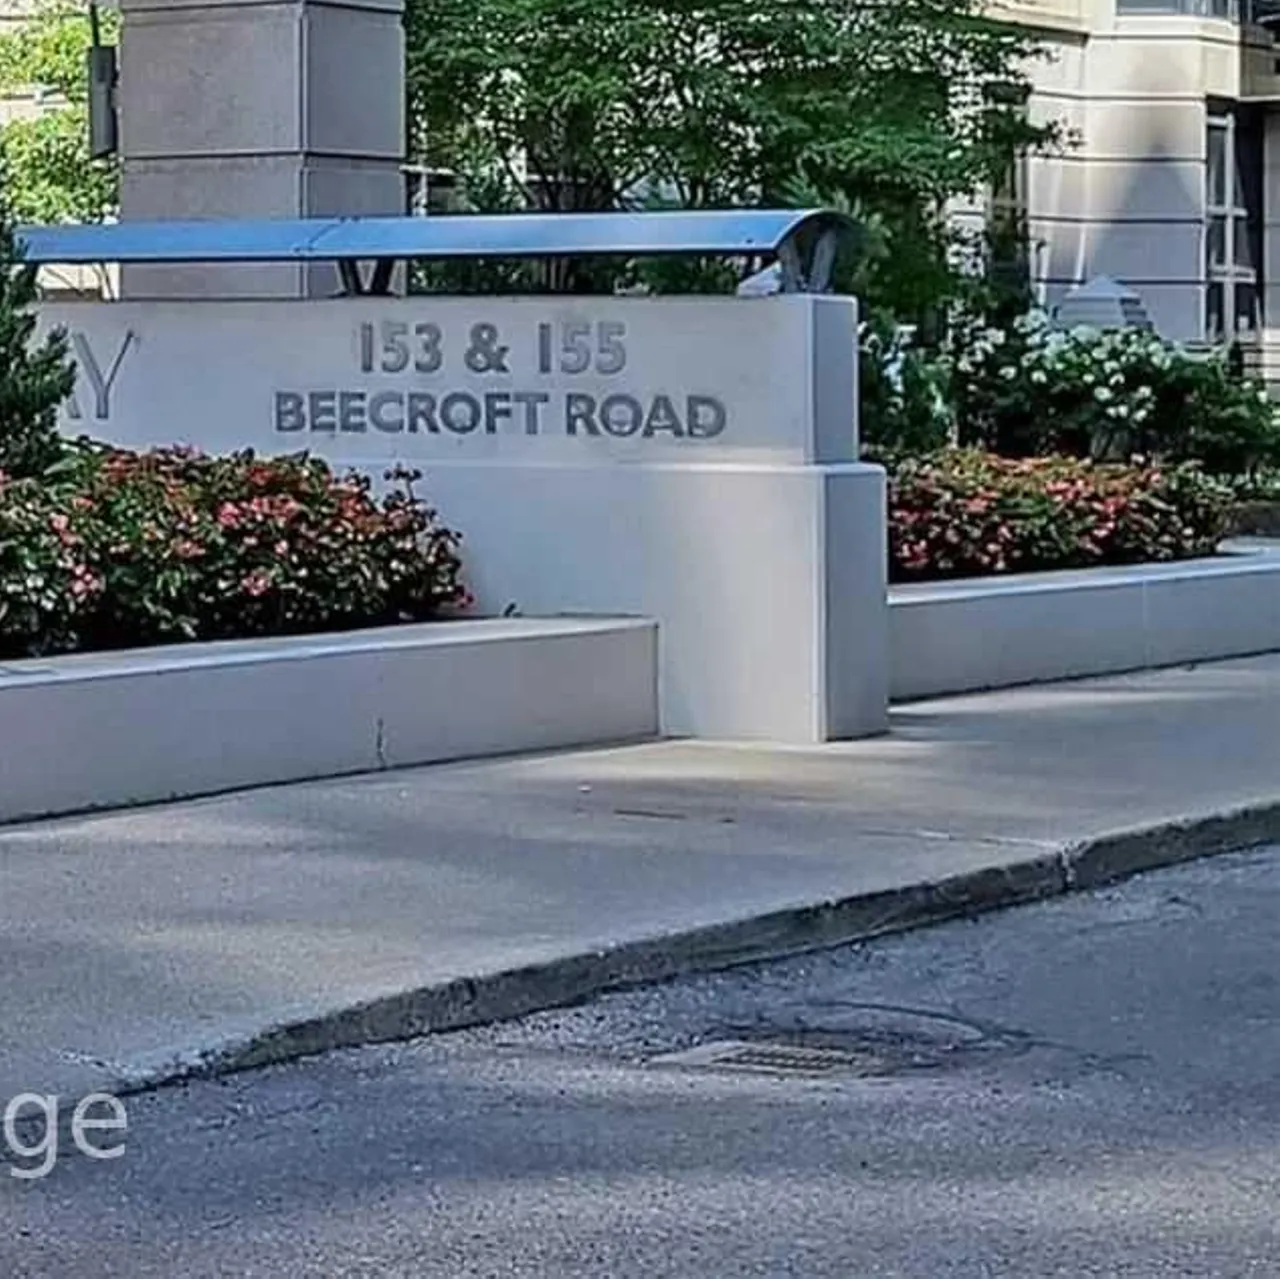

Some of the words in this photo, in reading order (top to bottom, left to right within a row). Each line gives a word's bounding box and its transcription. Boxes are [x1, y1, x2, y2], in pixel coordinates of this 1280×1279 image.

[360, 322, 443, 374] 153
[464, 322, 510, 374] &
[539, 322, 627, 375] 155
[274, 390, 548, 436] BEECROFT
[566, 394, 727, 438] ROAD
